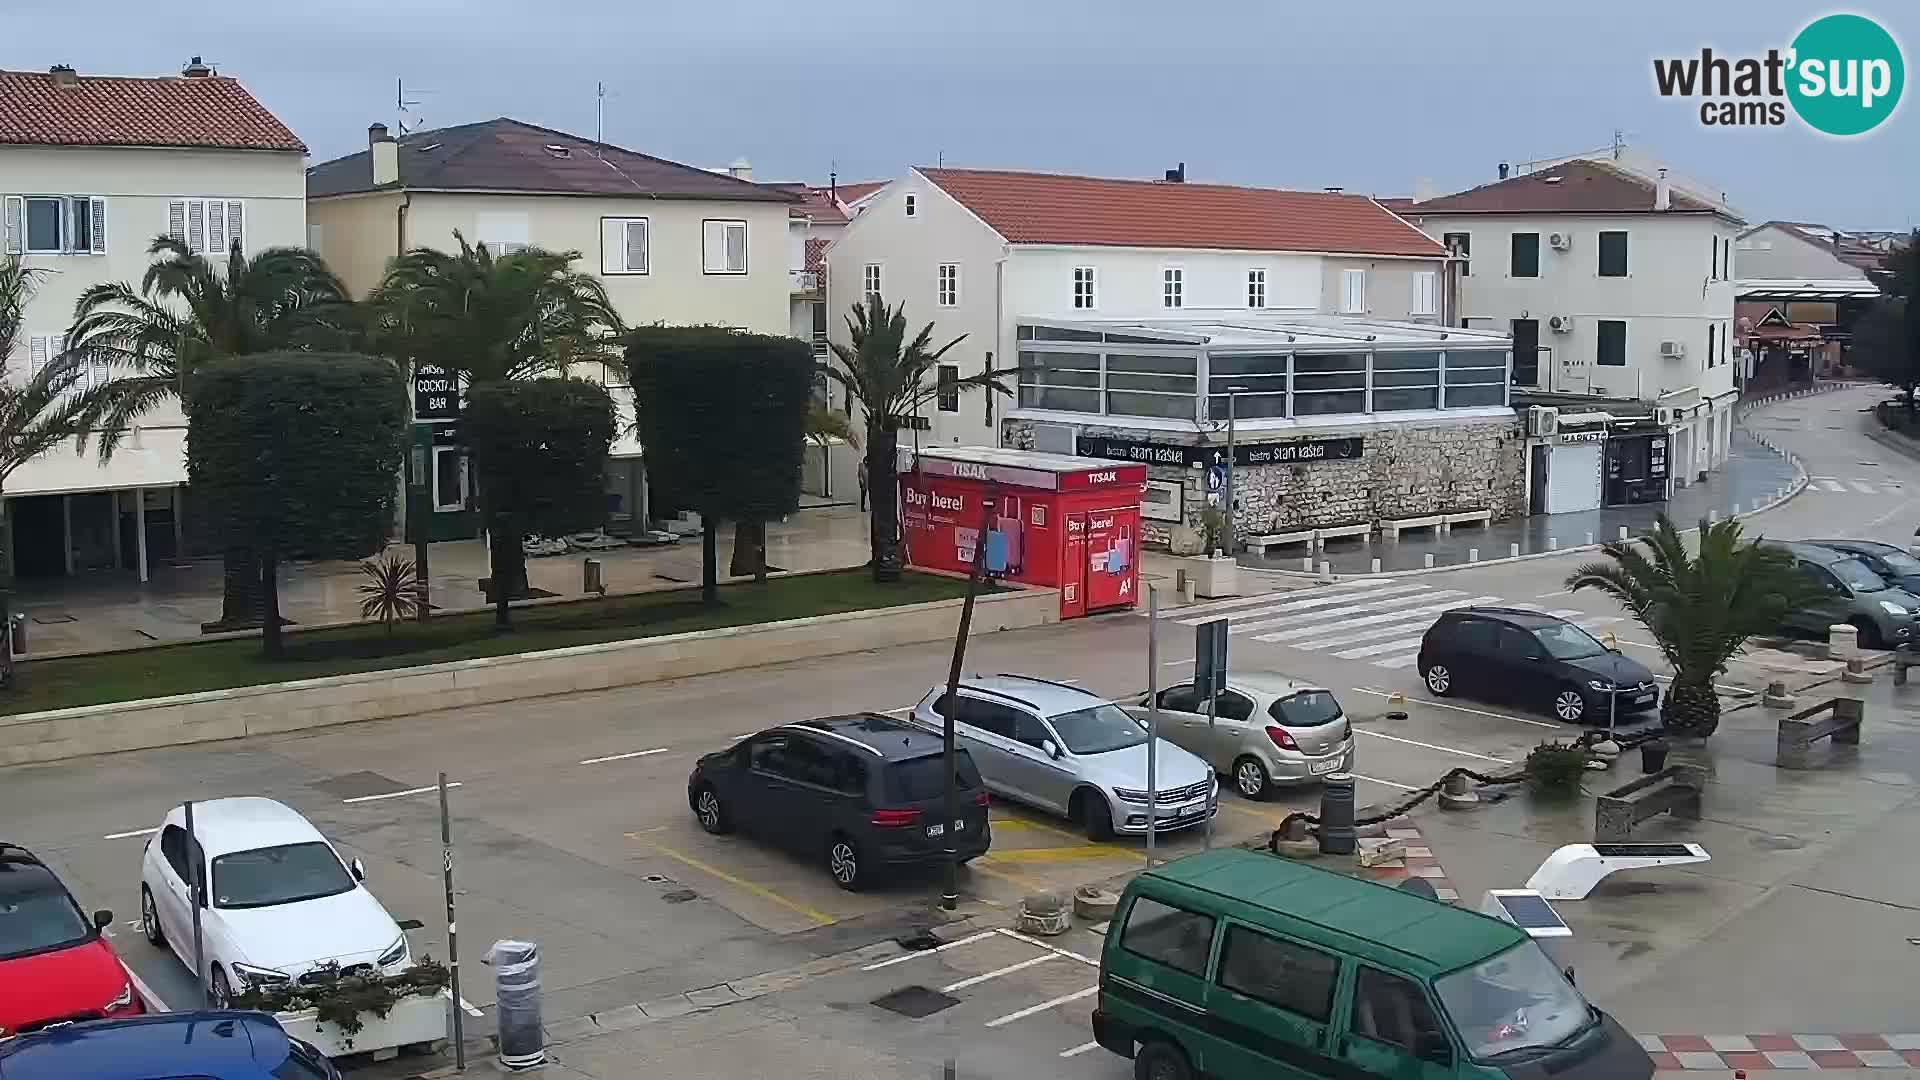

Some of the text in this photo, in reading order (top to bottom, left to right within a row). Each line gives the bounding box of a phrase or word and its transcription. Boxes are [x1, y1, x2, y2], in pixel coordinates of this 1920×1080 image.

[429, 397, 447, 410] BAR
[1106, 443, 1127, 457] bistro
[1130, 446, 1153, 461] stari
[1273, 446, 1296, 461] stari
[951, 462, 988, 481] TISAK
[1087, 471, 1117, 484] TISAK
[906, 487, 964, 511] Buy here!
[1068, 515, 1114, 533] Buy here!
[1119, 577, 1131, 597] A1
